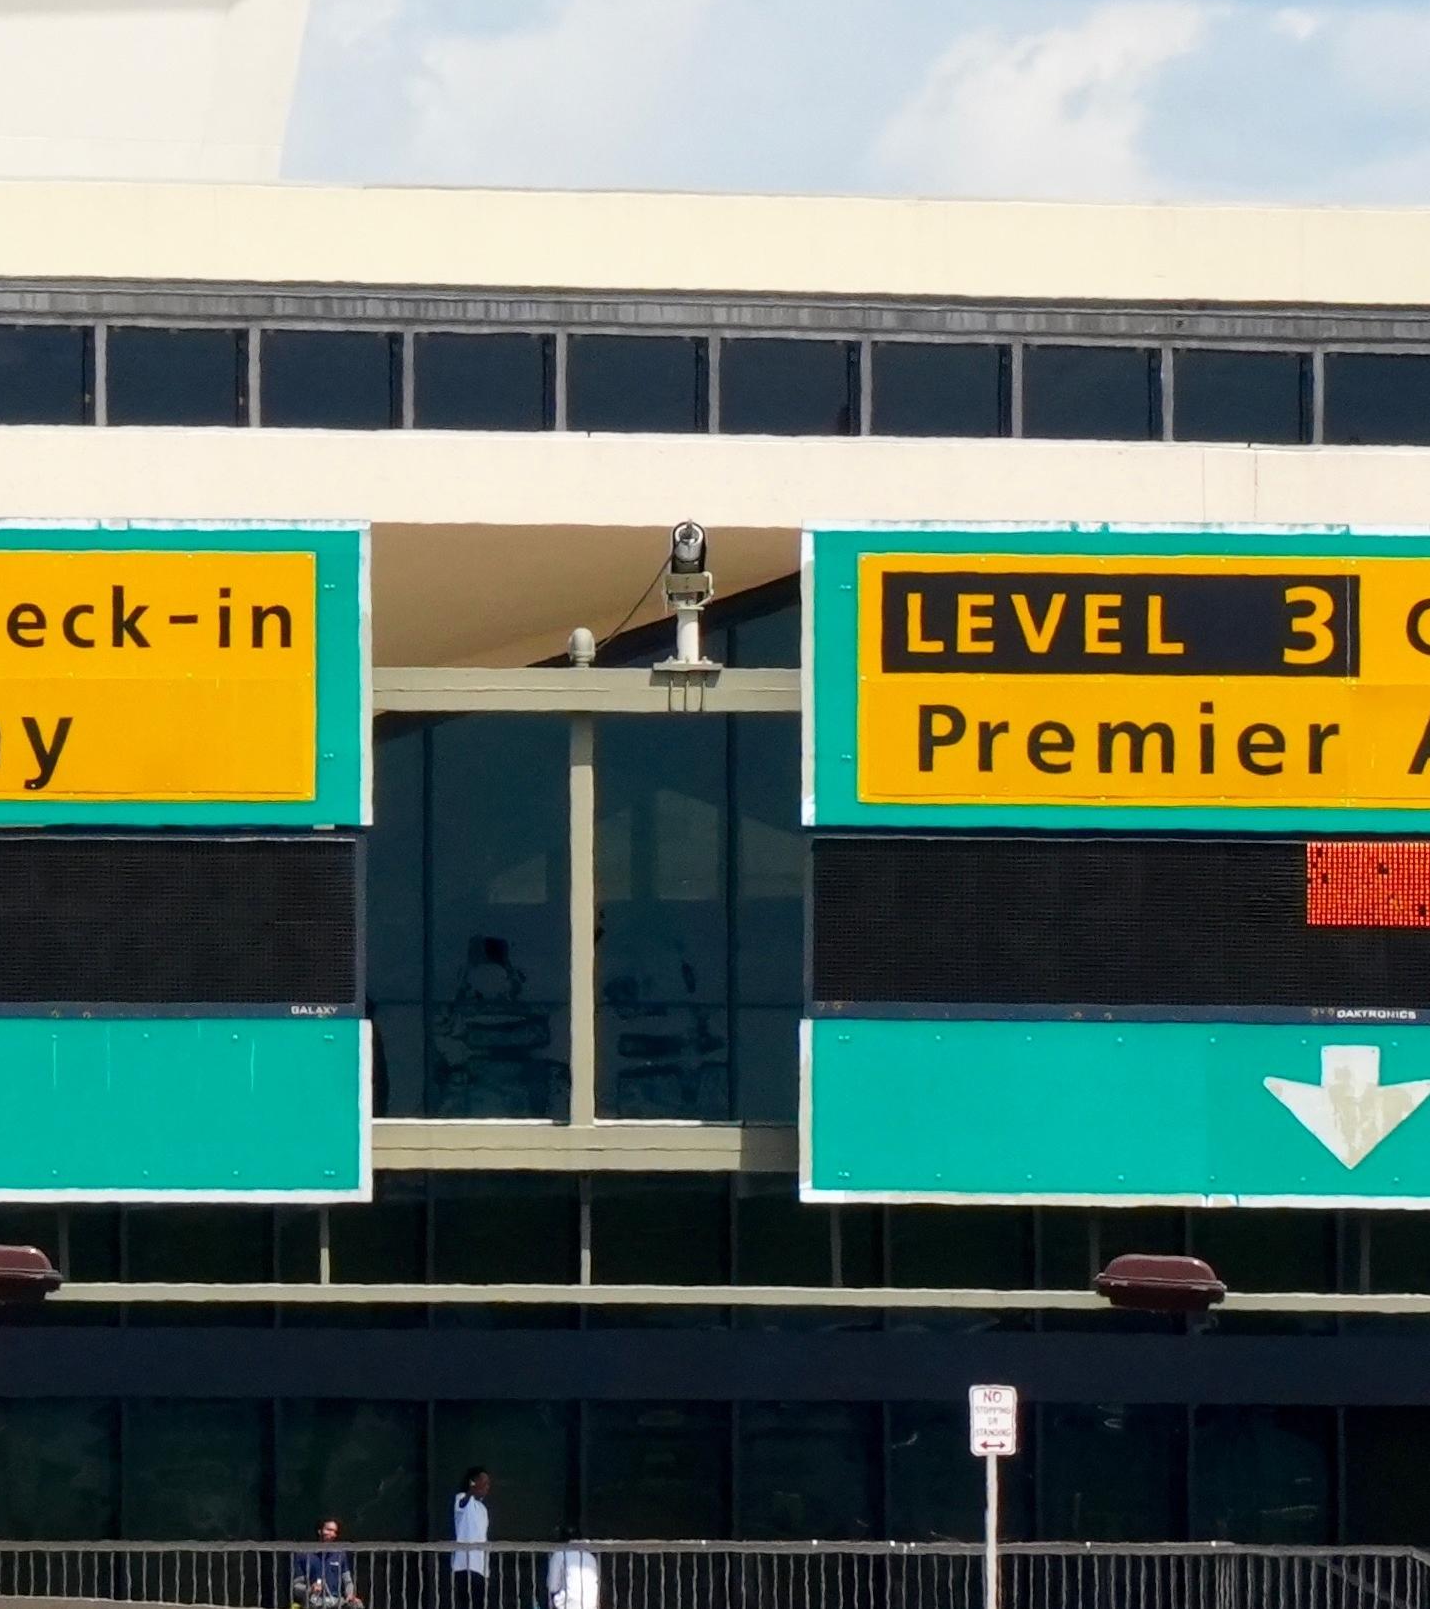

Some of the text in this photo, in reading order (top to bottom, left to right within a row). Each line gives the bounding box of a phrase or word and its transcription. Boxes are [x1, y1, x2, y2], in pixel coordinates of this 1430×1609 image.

[907, 592, 1185, 655] LEVEL
[1283, 586, 1335, 665] 3
[919, 702, 1339, 776] Premier
[291, 1005, 338, 1015] GALAXY
[983, 1390, 1003, 1404] NO
